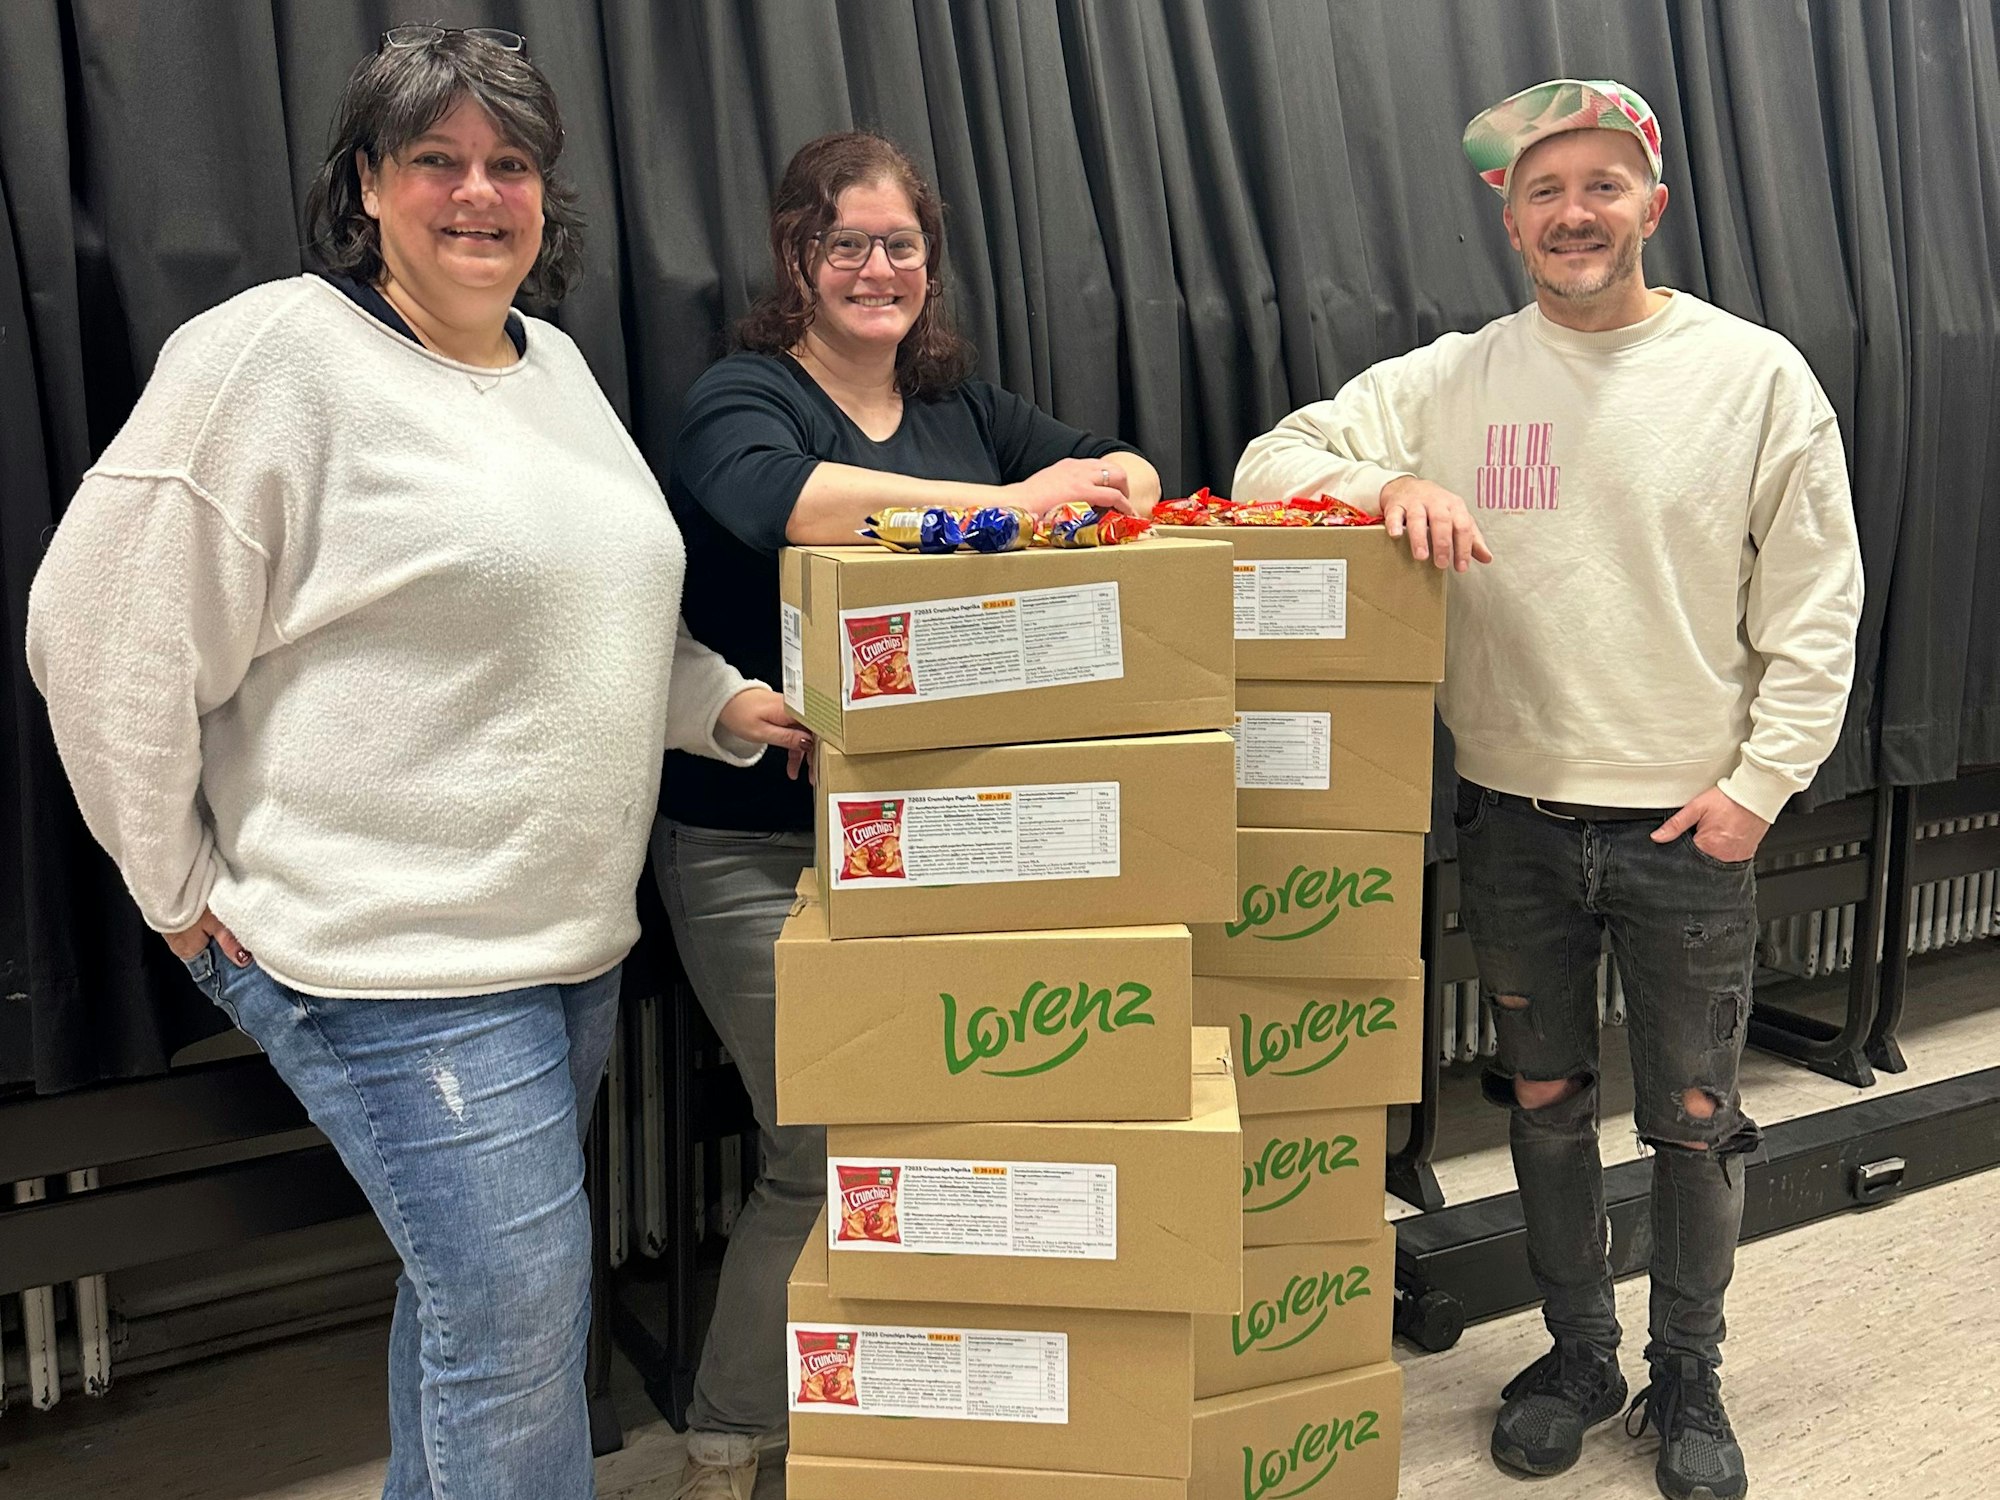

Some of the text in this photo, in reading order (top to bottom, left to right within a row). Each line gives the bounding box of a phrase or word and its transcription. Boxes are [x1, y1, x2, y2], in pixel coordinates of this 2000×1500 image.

[1485, 422, 1553, 466] EAU DE
[1476, 466, 1560, 510] COLOGNE
[933, 606, 960, 614] Crunchips
[861, 637, 901, 662] Crunchips
[852, 822, 893, 844] Crunchips
[1225, 865, 1394, 941] orenz
[939, 980, 1155, 1077] Lorenz
[1239, 997, 1397, 1078] Lorenz
[850, 1187, 889, 1208] Crunchips
[809, 1351, 846, 1371] Crunchips
[1242, 1410, 1380, 1500] Lorenz
